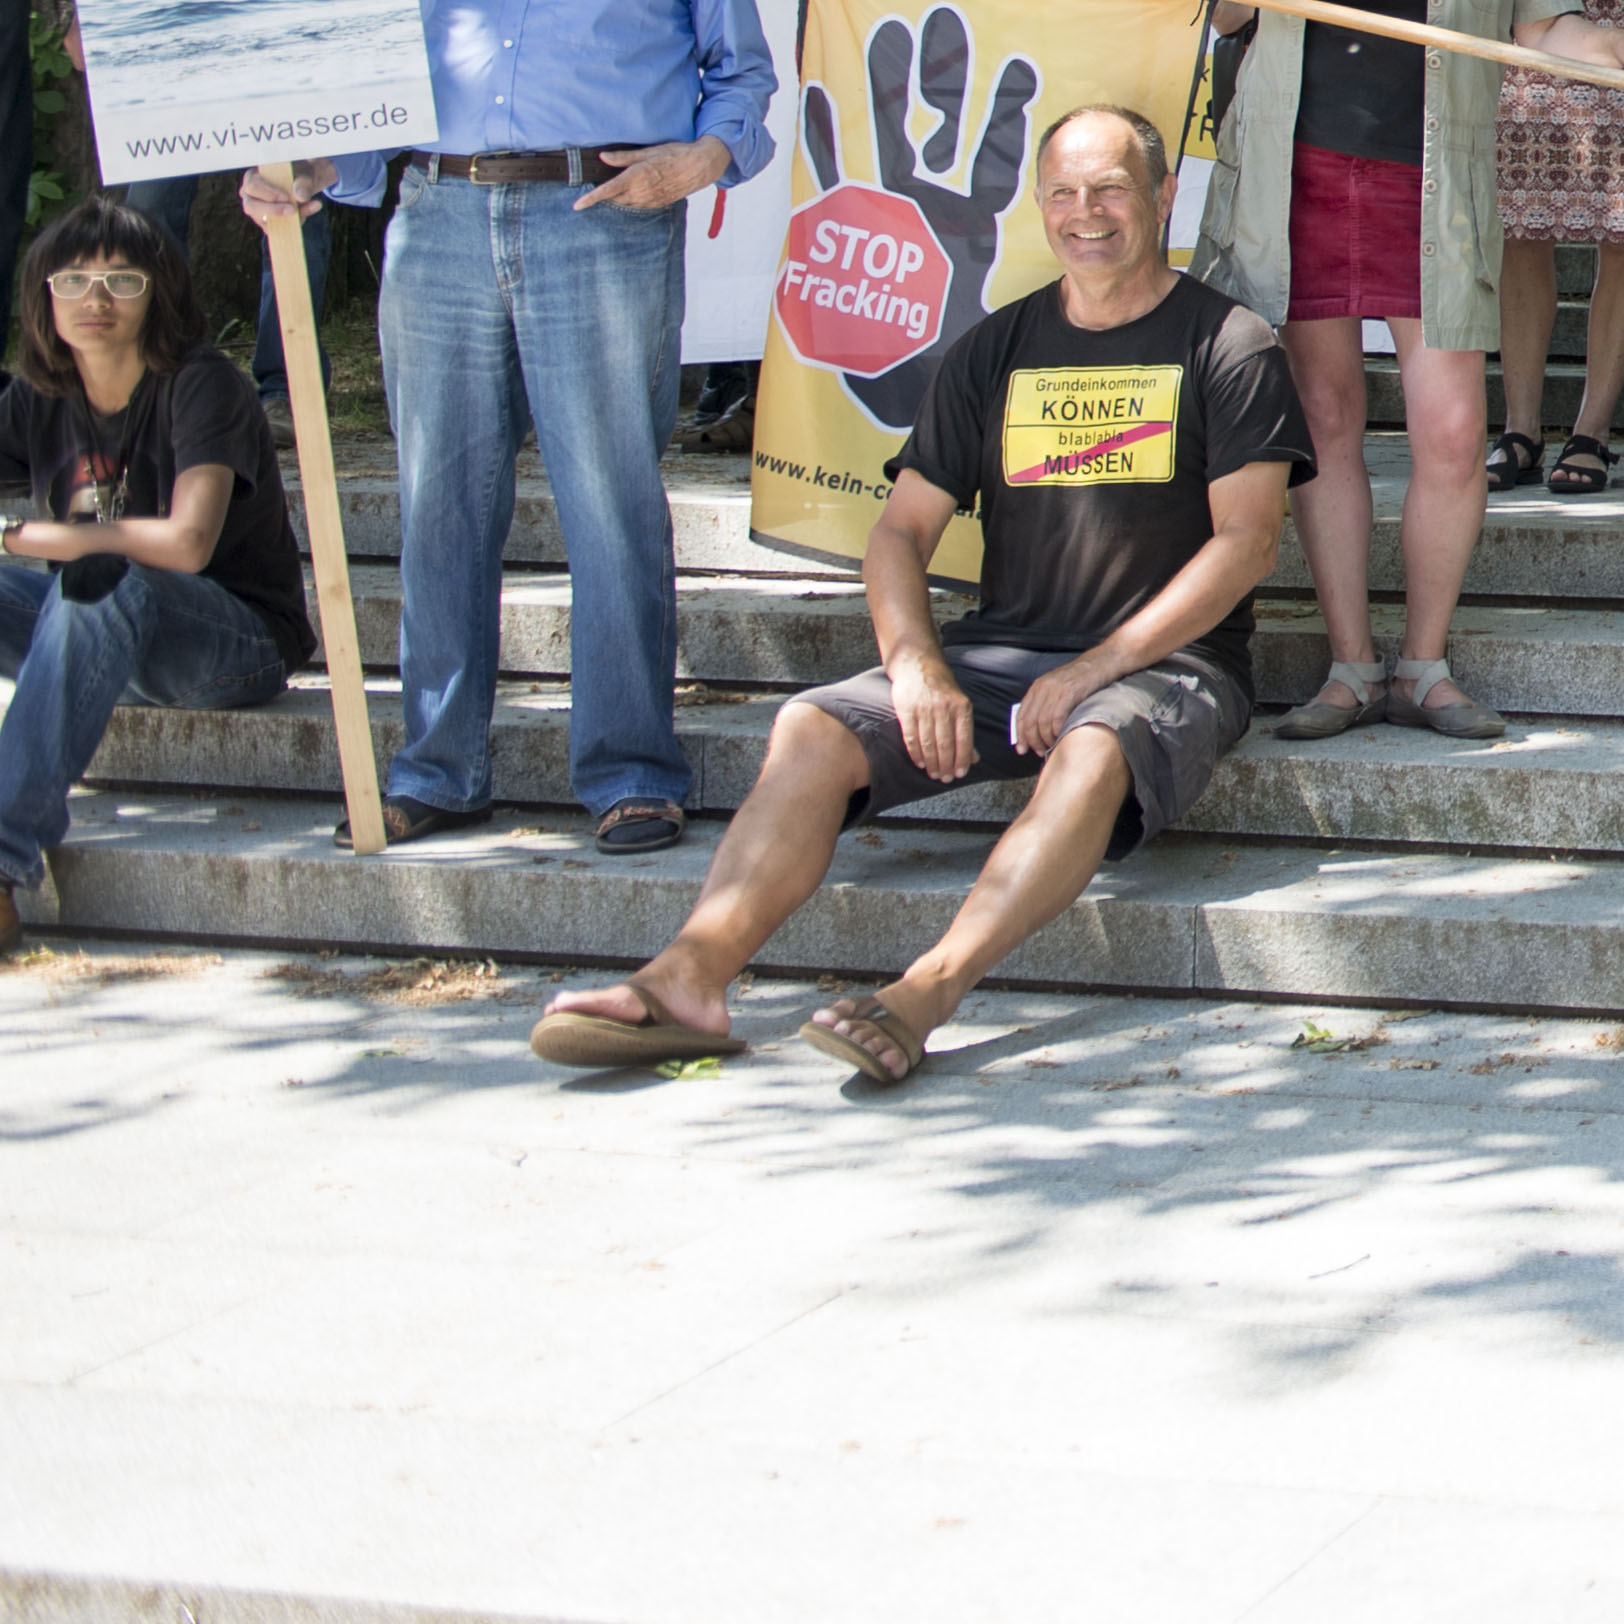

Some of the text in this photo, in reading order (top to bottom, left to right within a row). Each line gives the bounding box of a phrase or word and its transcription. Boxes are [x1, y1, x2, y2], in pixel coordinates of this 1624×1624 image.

[126, 103, 409, 159] www.vi-wasser.de
[809, 219, 924, 284] STOP
[783, 259, 929, 340] Fracking
[1036, 377, 1156, 392] Grundeinkommen
[1041, 395, 1144, 421] KÖNNEN
[1059, 431, 1124, 446] blablabla
[1043, 450, 1134, 476] MÜSSEN
